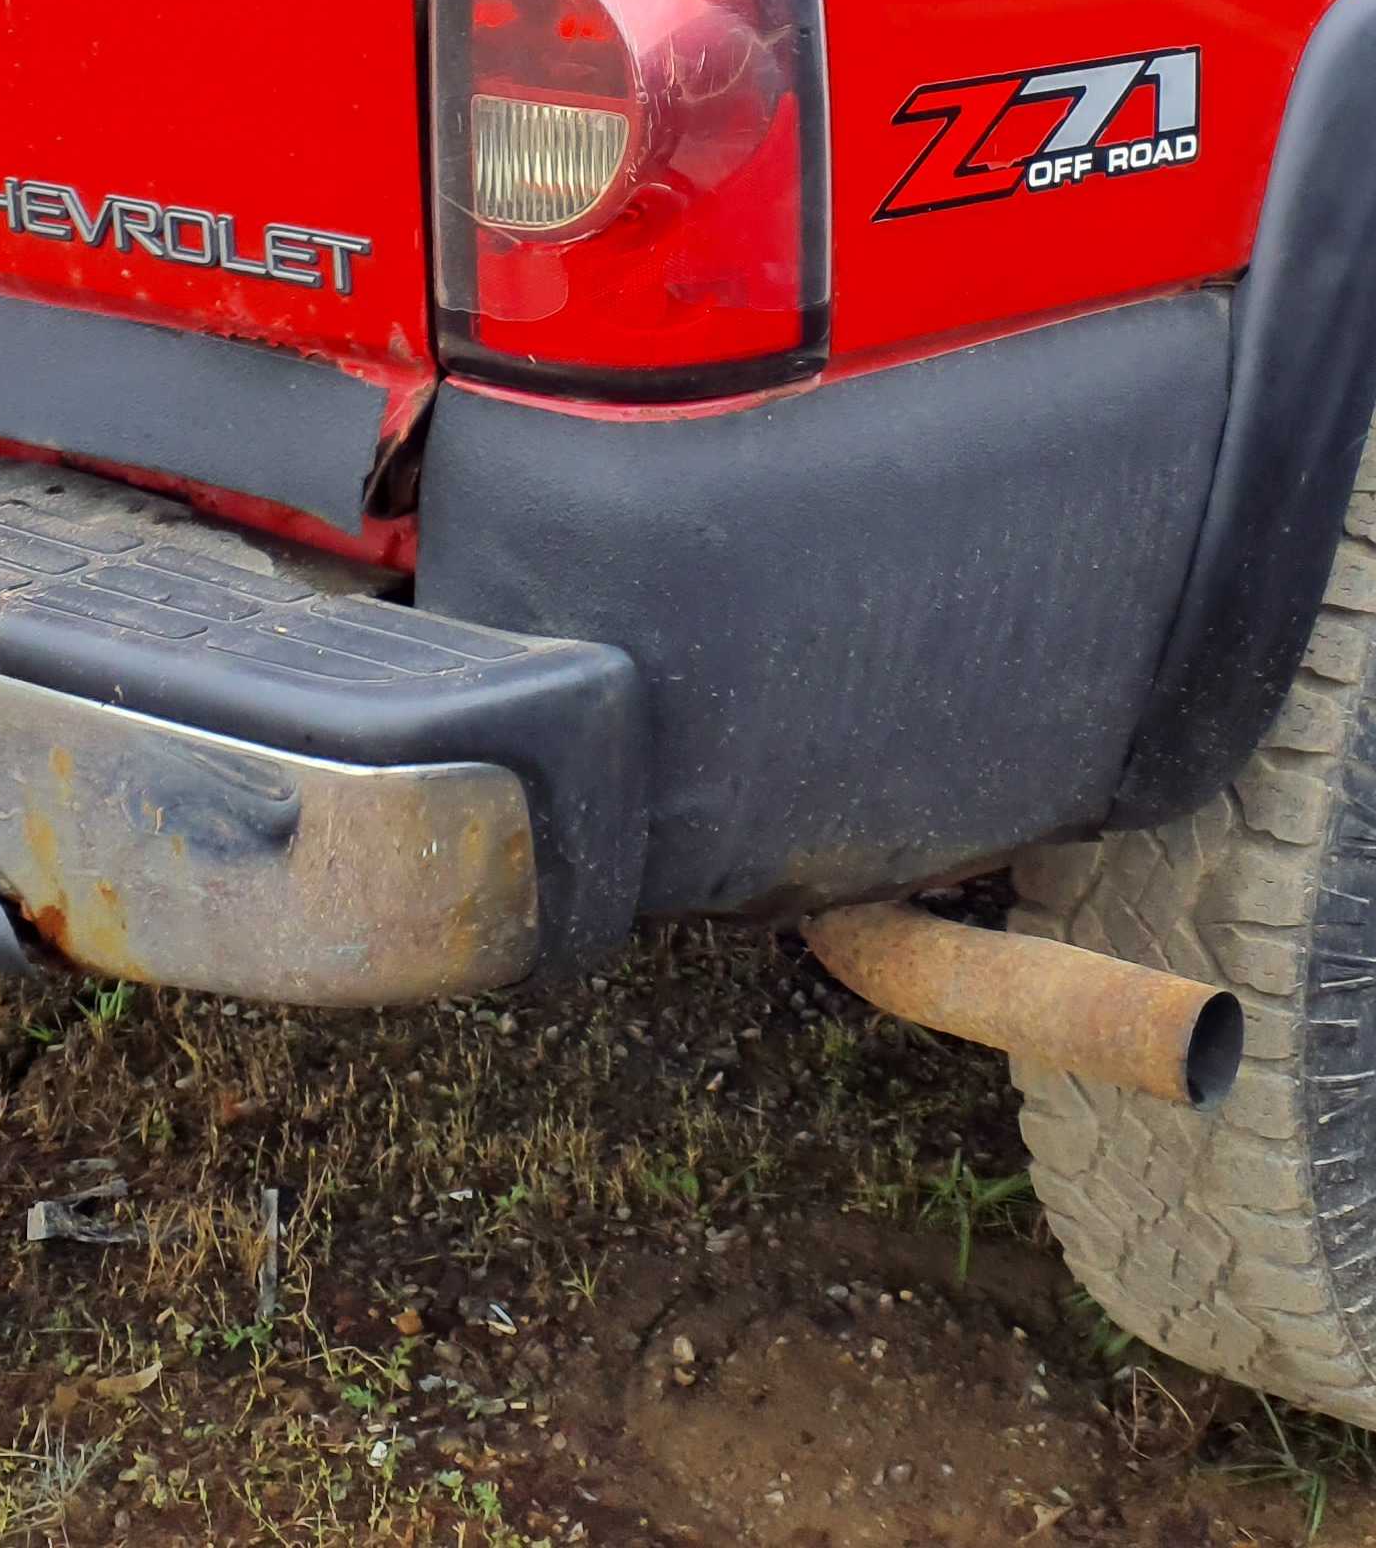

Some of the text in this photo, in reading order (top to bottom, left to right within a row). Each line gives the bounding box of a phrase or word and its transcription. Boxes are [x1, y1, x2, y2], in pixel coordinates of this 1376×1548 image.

[870, 44, 1201, 223] Z71
[1028, 135, 1198, 189] OFF ROAD
